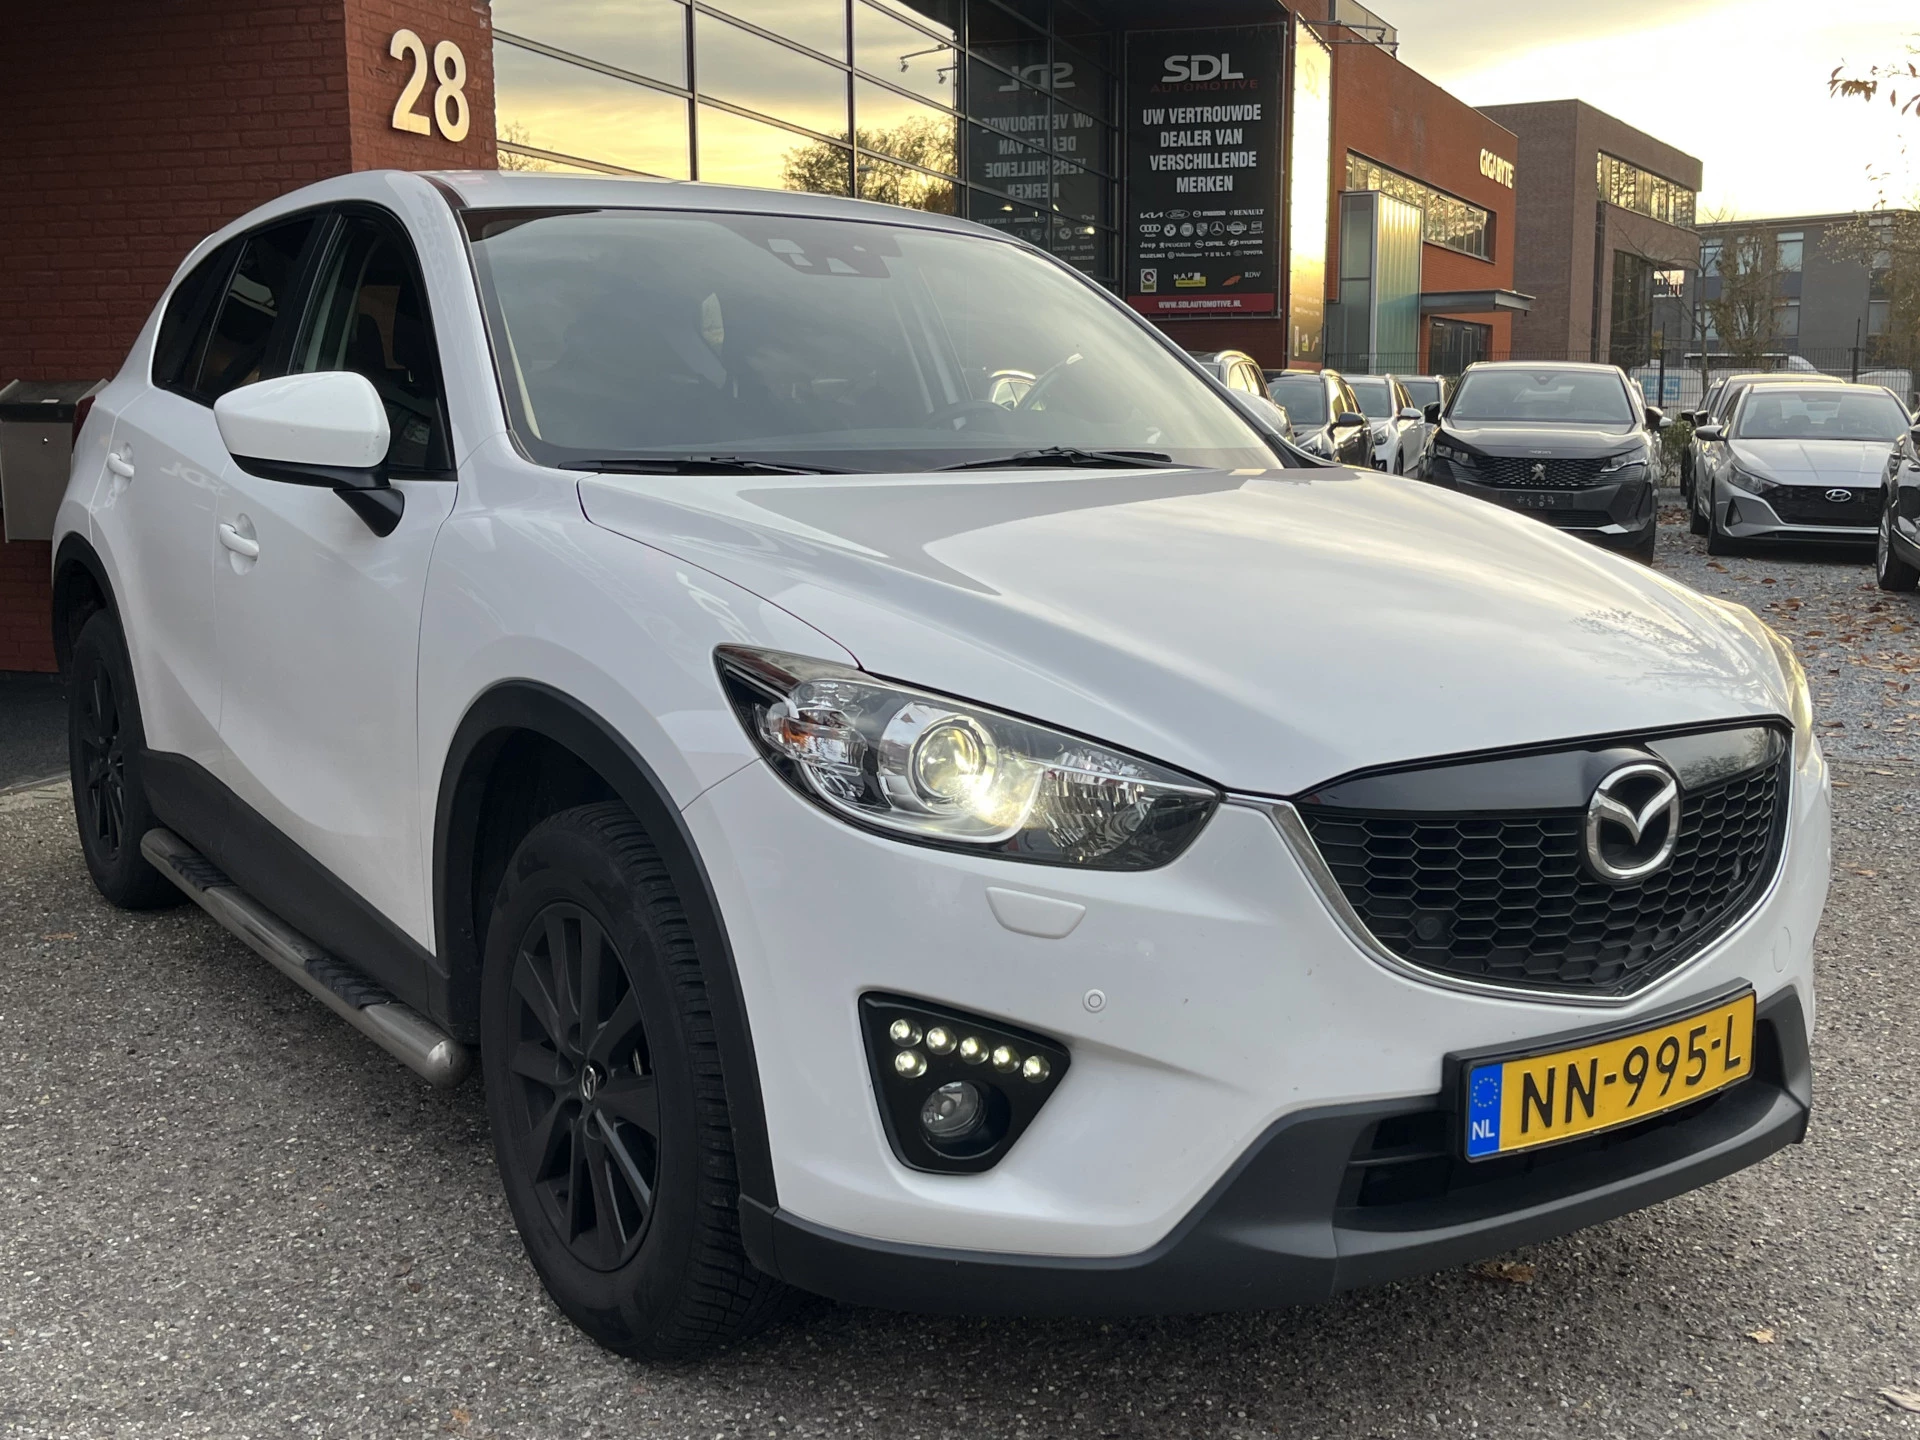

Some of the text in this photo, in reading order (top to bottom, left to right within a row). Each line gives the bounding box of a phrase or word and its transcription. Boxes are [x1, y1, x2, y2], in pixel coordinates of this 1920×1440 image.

[1161, 53, 1244, 82] SDL
[390, 28, 470, 142] 28
[1151, 79, 1258, 93] AUTOMOTIVE
[1142, 104, 1261, 125] UW VERTROUWDE
[1160, 128, 1243, 147] DEALER VAN
[1150, 151, 1257, 171] VERSCHILLENDE
[1176, 175, 1233, 193] MERKEN
[1140, 241, 1156, 249] Jeep
[1520, 1013, 1741, 1134] NN-995-L
[1471, 1119, 1495, 1141] NL
